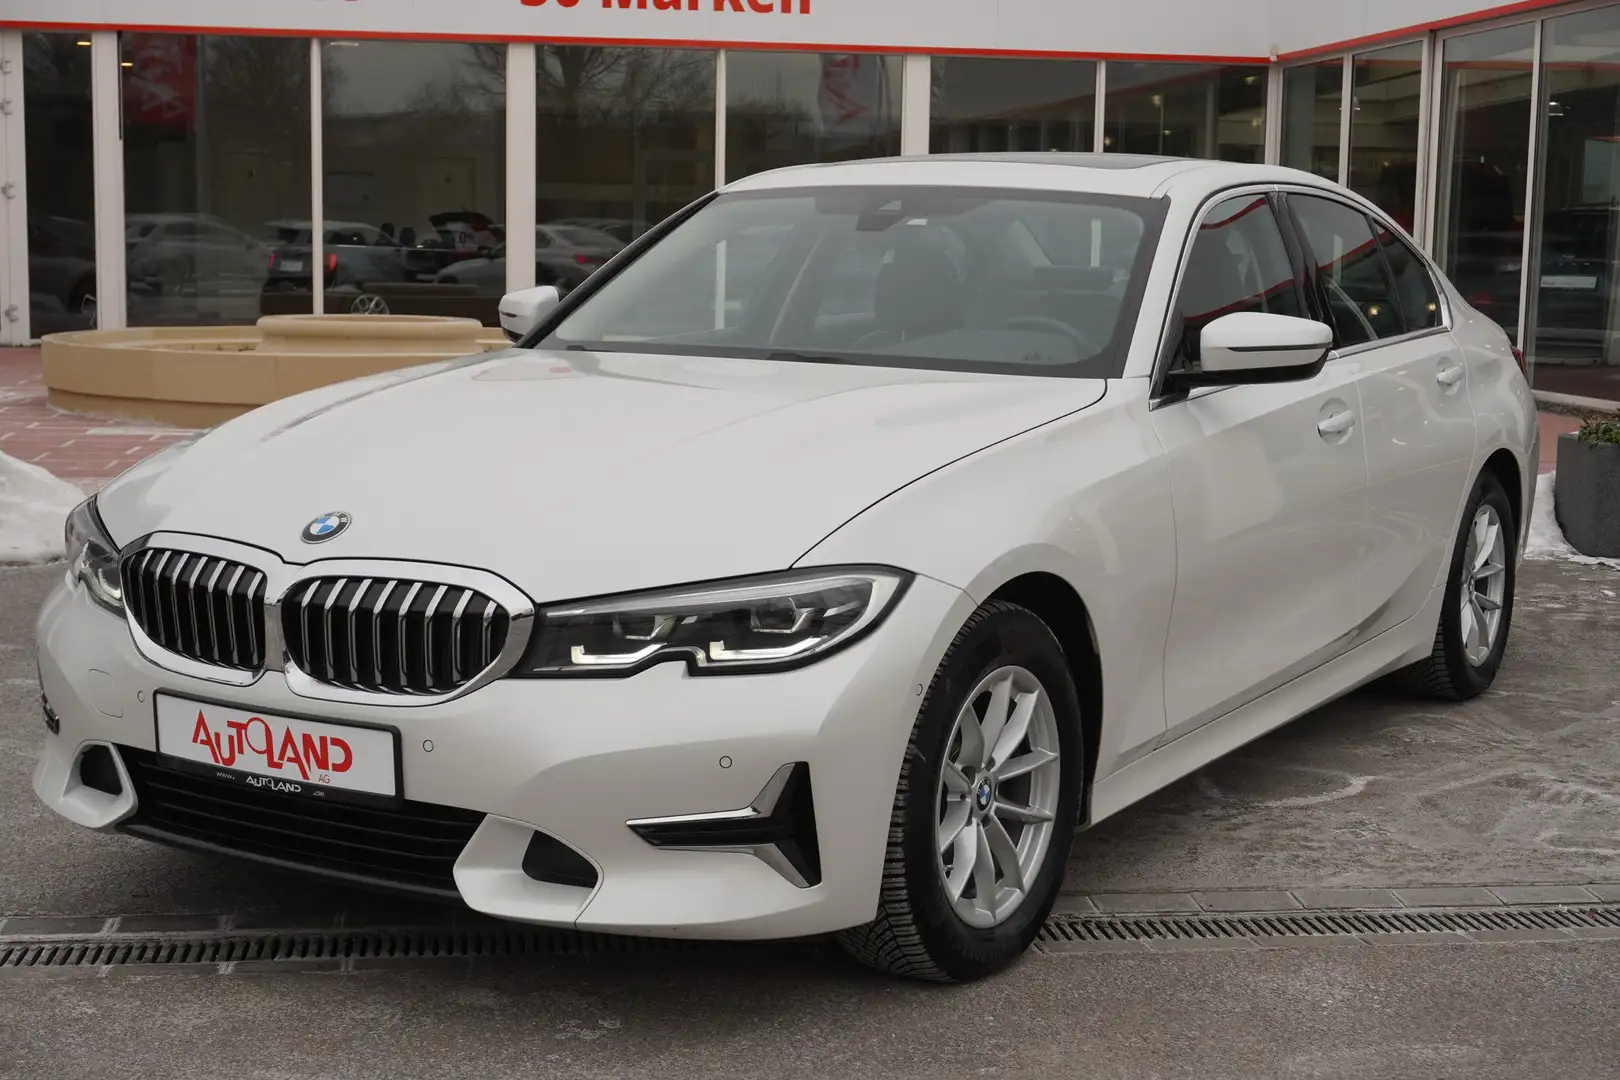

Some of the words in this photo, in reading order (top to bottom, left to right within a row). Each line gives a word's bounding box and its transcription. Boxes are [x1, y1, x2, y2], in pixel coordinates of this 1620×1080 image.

[192, 709, 353, 780] AUTOLAND
[245, 775, 302, 793] AUTOLAND
[318, 773, 331, 784] AG
